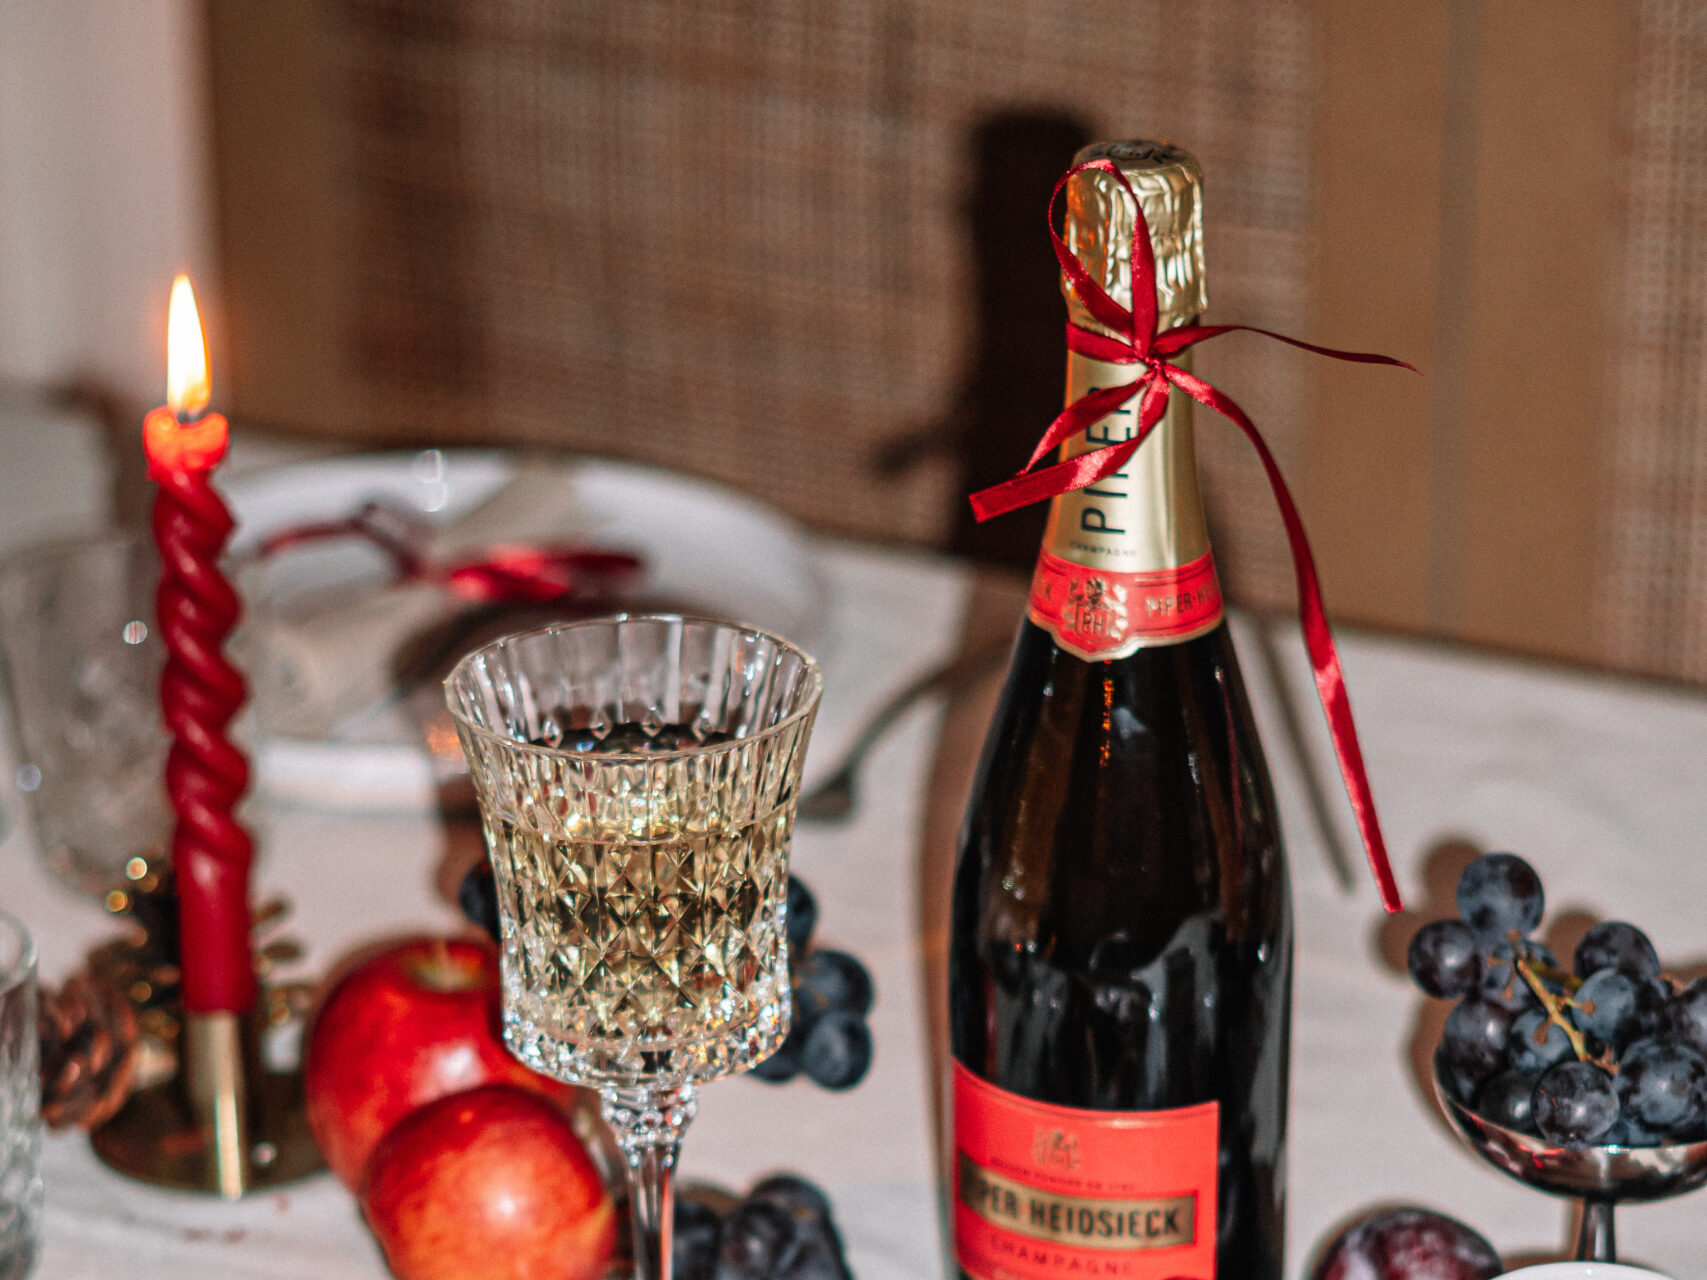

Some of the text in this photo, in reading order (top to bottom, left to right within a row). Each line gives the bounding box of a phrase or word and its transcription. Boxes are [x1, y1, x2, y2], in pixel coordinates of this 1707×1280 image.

[1080, 386, 1131, 534] PIE
[1029, 1197, 1180, 1238] HEIDSIECK
[991, 1233, 1131, 1275] CHAMPAGNE
